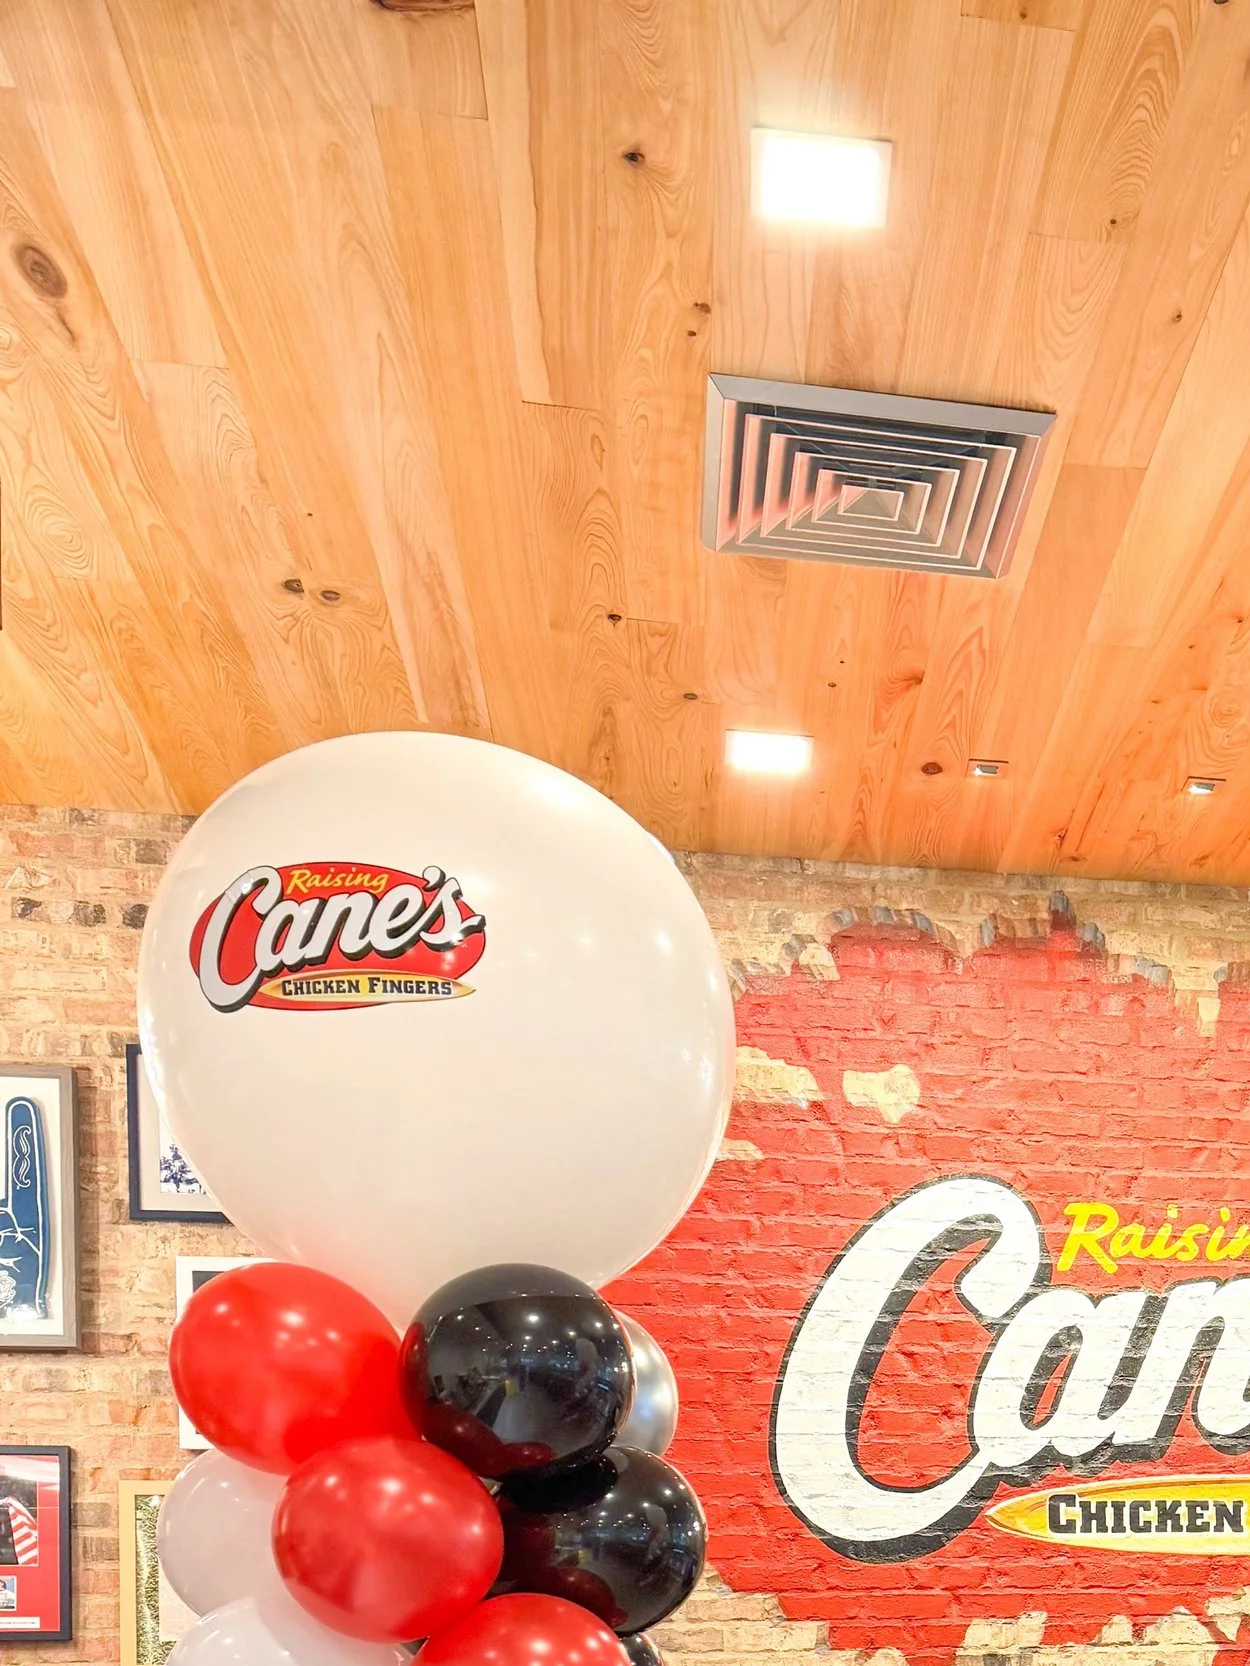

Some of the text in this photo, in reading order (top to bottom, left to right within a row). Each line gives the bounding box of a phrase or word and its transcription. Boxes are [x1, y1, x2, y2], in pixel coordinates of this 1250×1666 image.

[287, 867, 389, 895] Raising
[199, 865, 487, 1013] Cane's
[281, 976, 452, 997] CHICKEN FINGERS
[1047, 1493, 1244, 1535] CHICKEN
